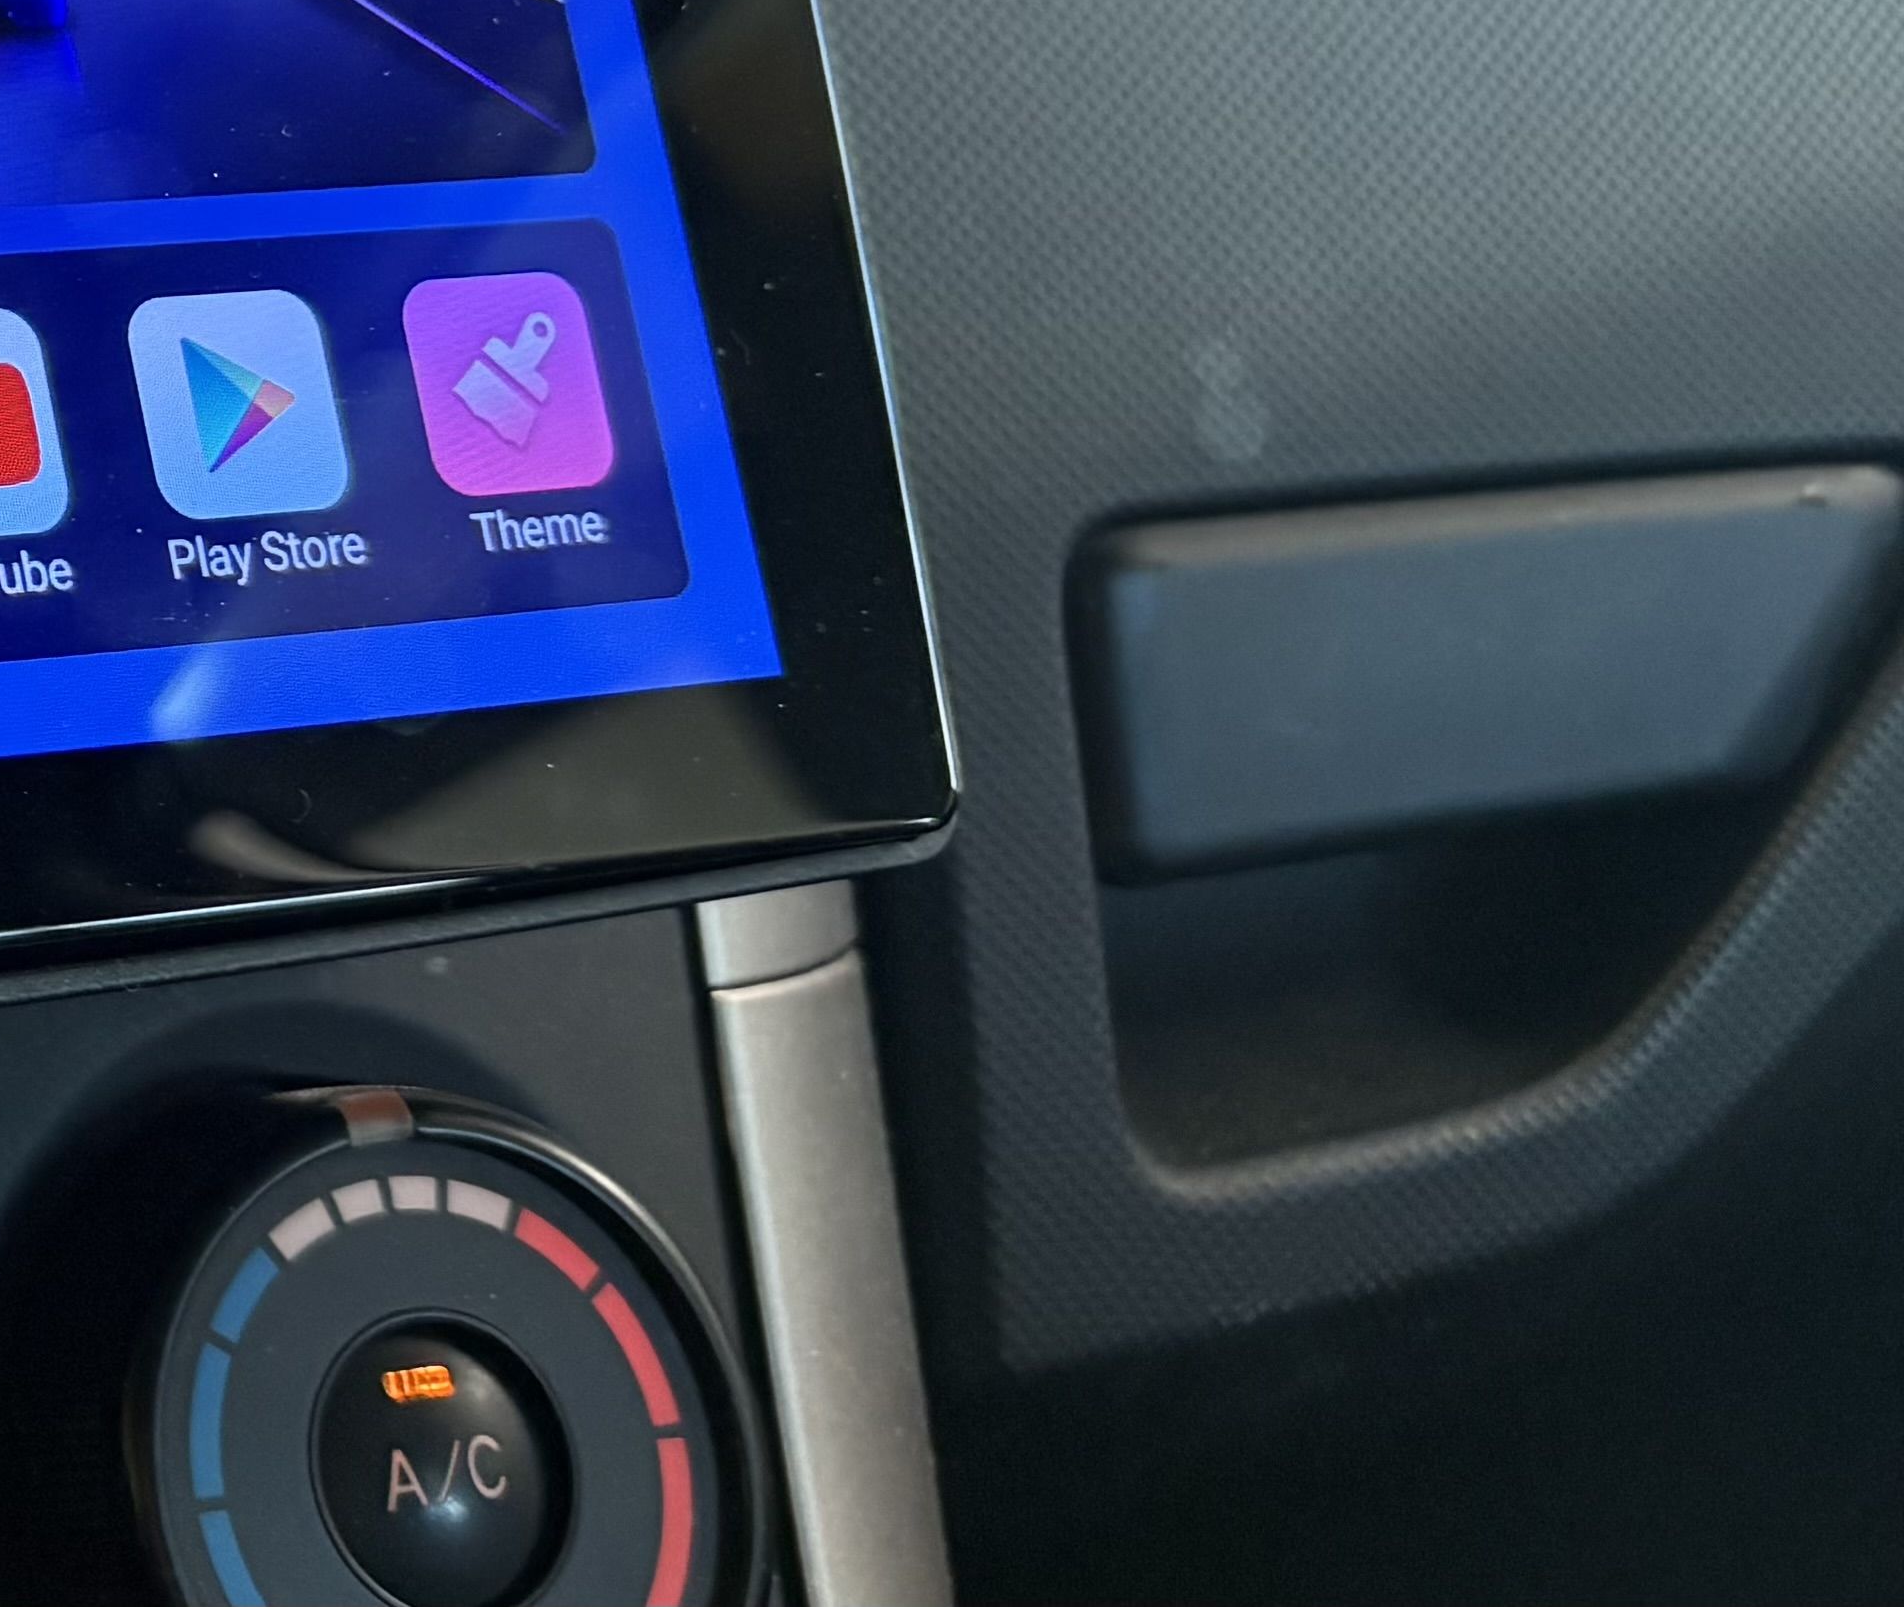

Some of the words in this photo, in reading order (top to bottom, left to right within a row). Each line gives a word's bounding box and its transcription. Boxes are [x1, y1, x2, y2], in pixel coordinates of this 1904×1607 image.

[166, 534, 258, 586] Play
[261, 525, 368, 570] Store
[469, 504, 605, 552] Theme
[386, 1434, 508, 1512] A/C
